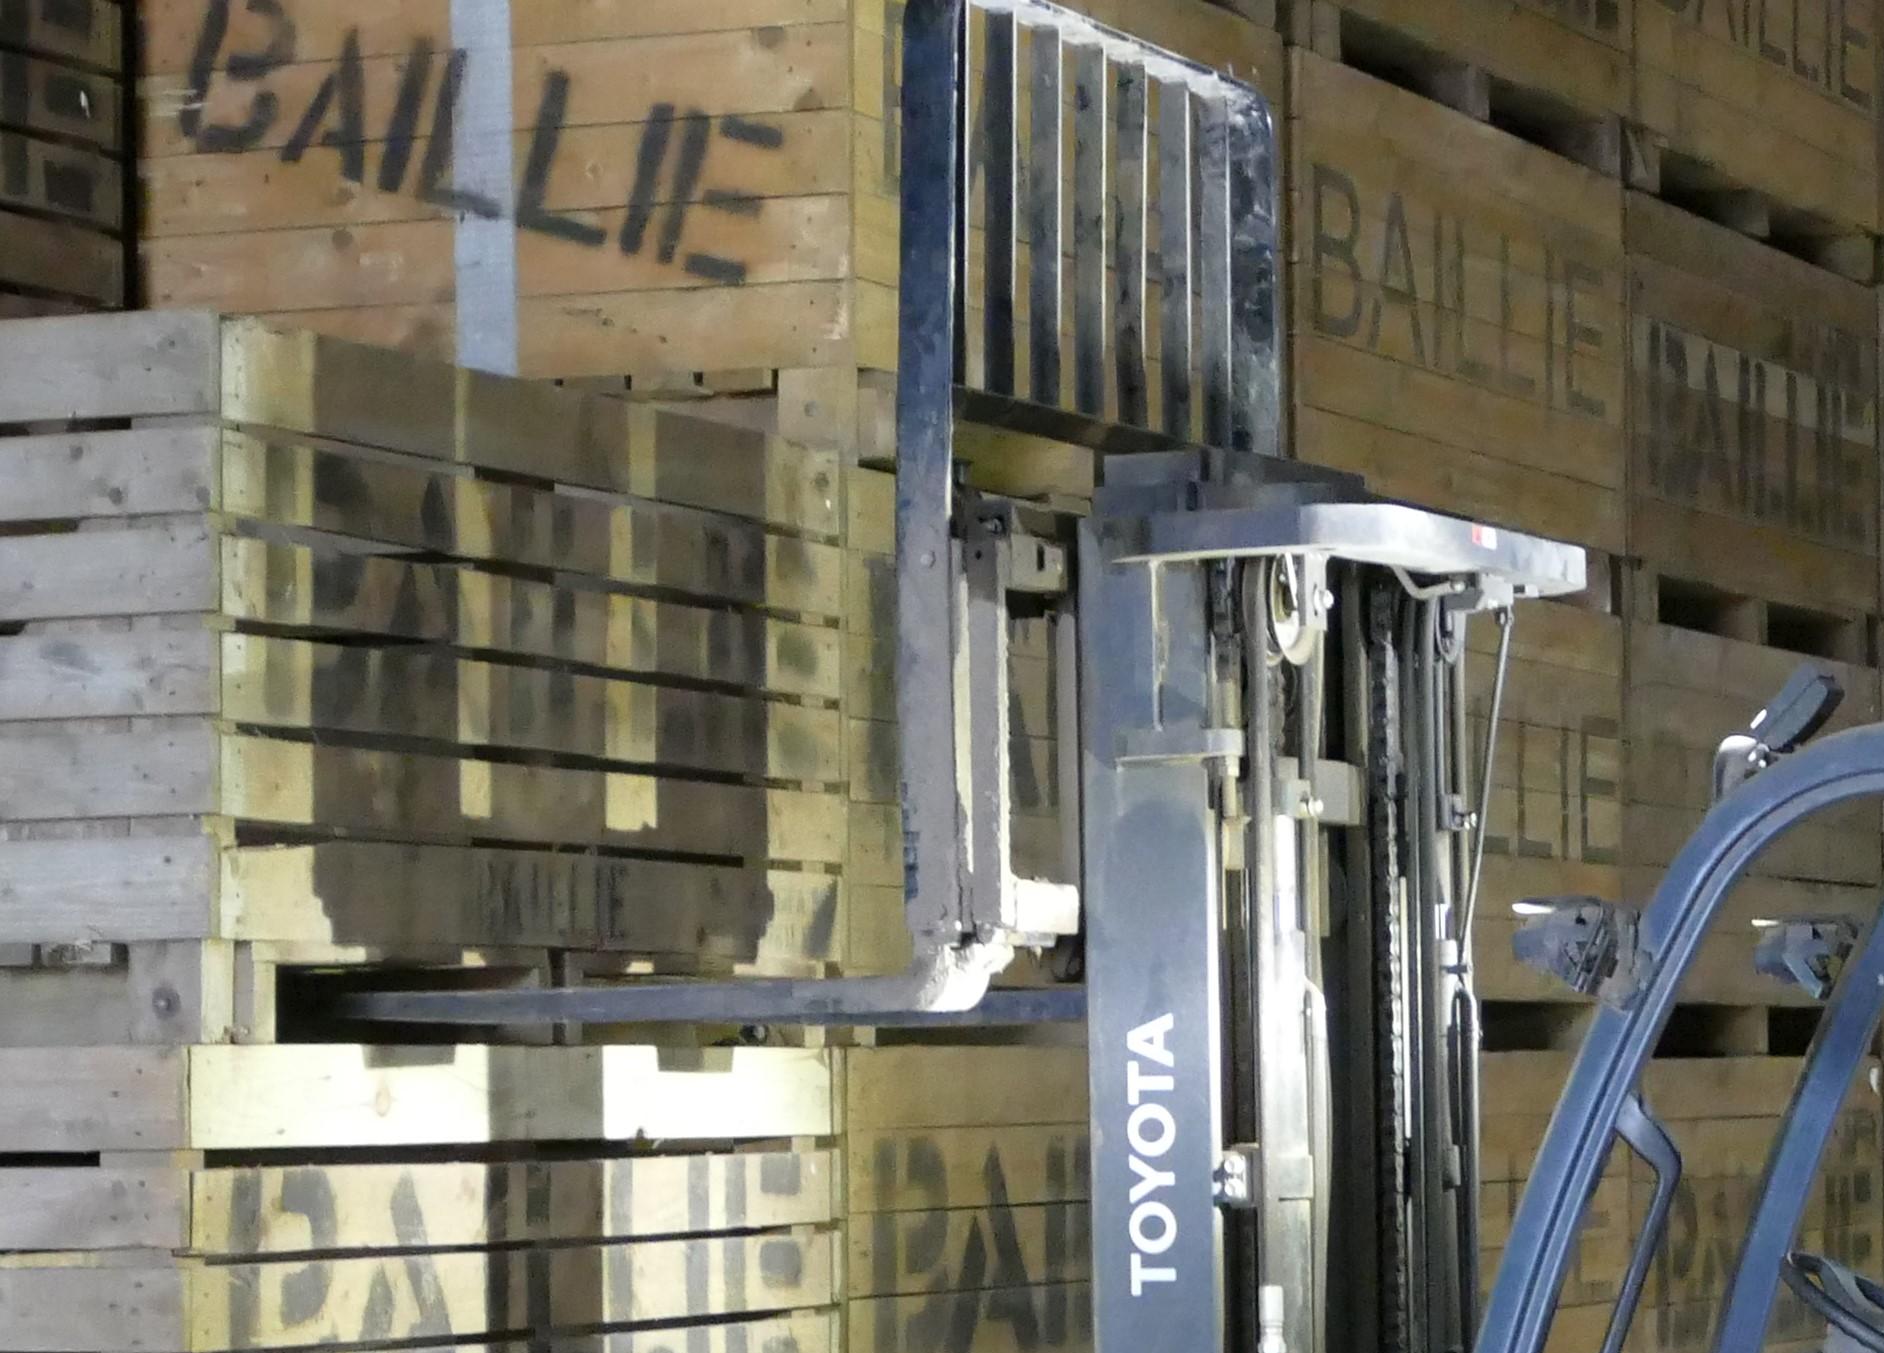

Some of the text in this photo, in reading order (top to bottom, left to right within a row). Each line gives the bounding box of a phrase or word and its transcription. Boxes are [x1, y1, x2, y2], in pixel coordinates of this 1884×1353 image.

[178, 0, 784, 285] BAILLIE
[1311, 163, 1606, 419] BAILLIE
[1126, 1012, 1177, 1297] TOYOTA
